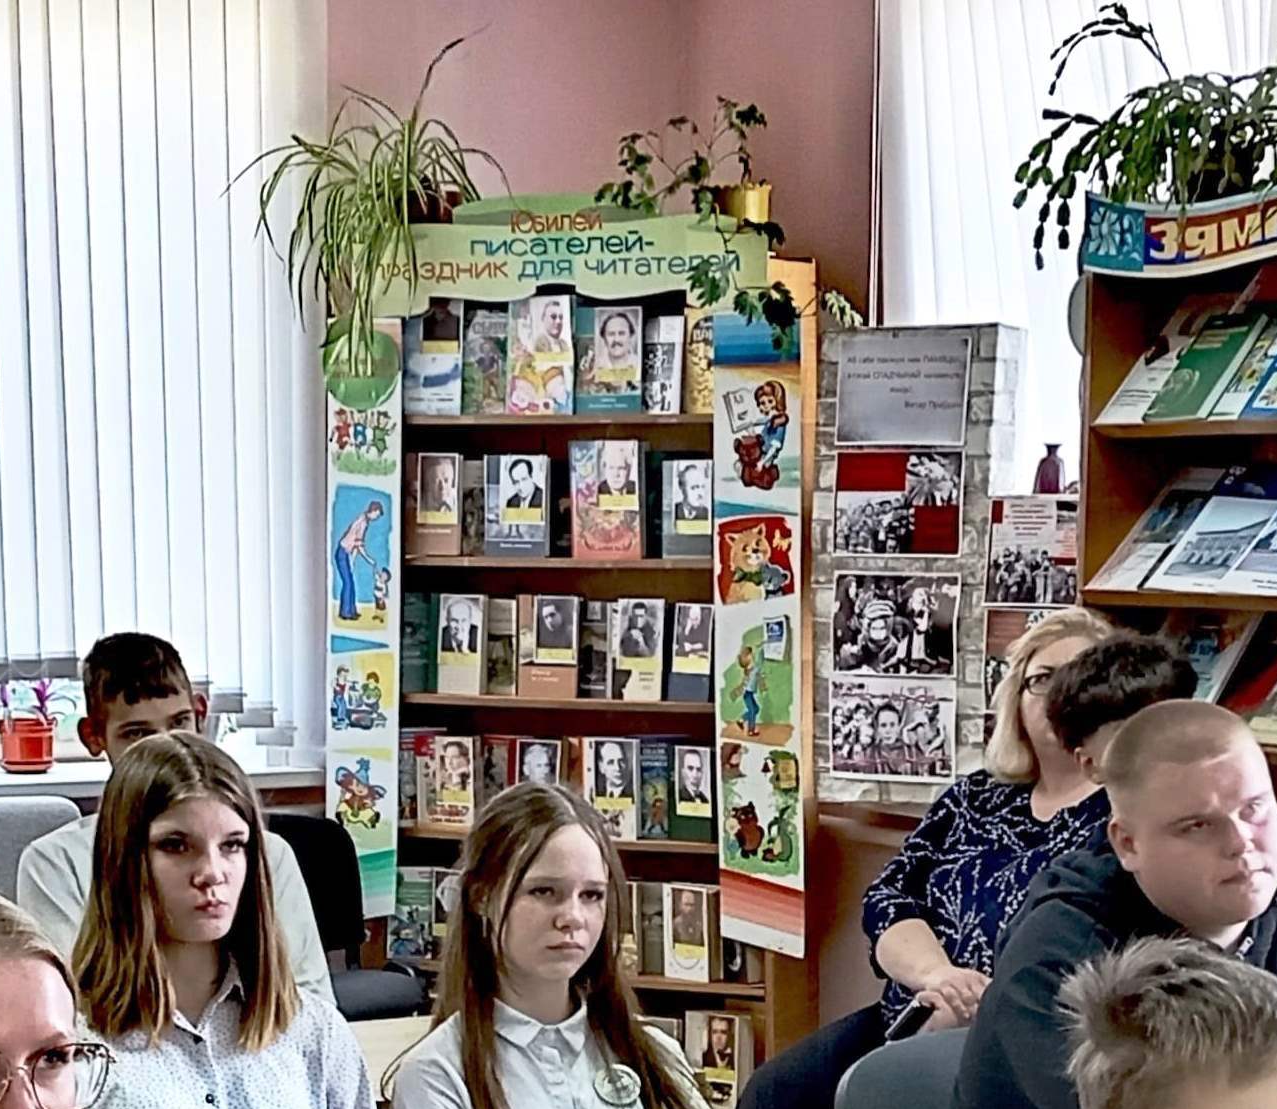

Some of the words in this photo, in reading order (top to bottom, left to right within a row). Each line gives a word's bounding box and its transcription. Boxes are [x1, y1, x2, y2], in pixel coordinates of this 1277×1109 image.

[510, 210, 603, 234] Юбилей
[470, 230, 654, 257] писателей-
[518, 257, 573, 281] для
[584, 250, 740, 277] читателей
